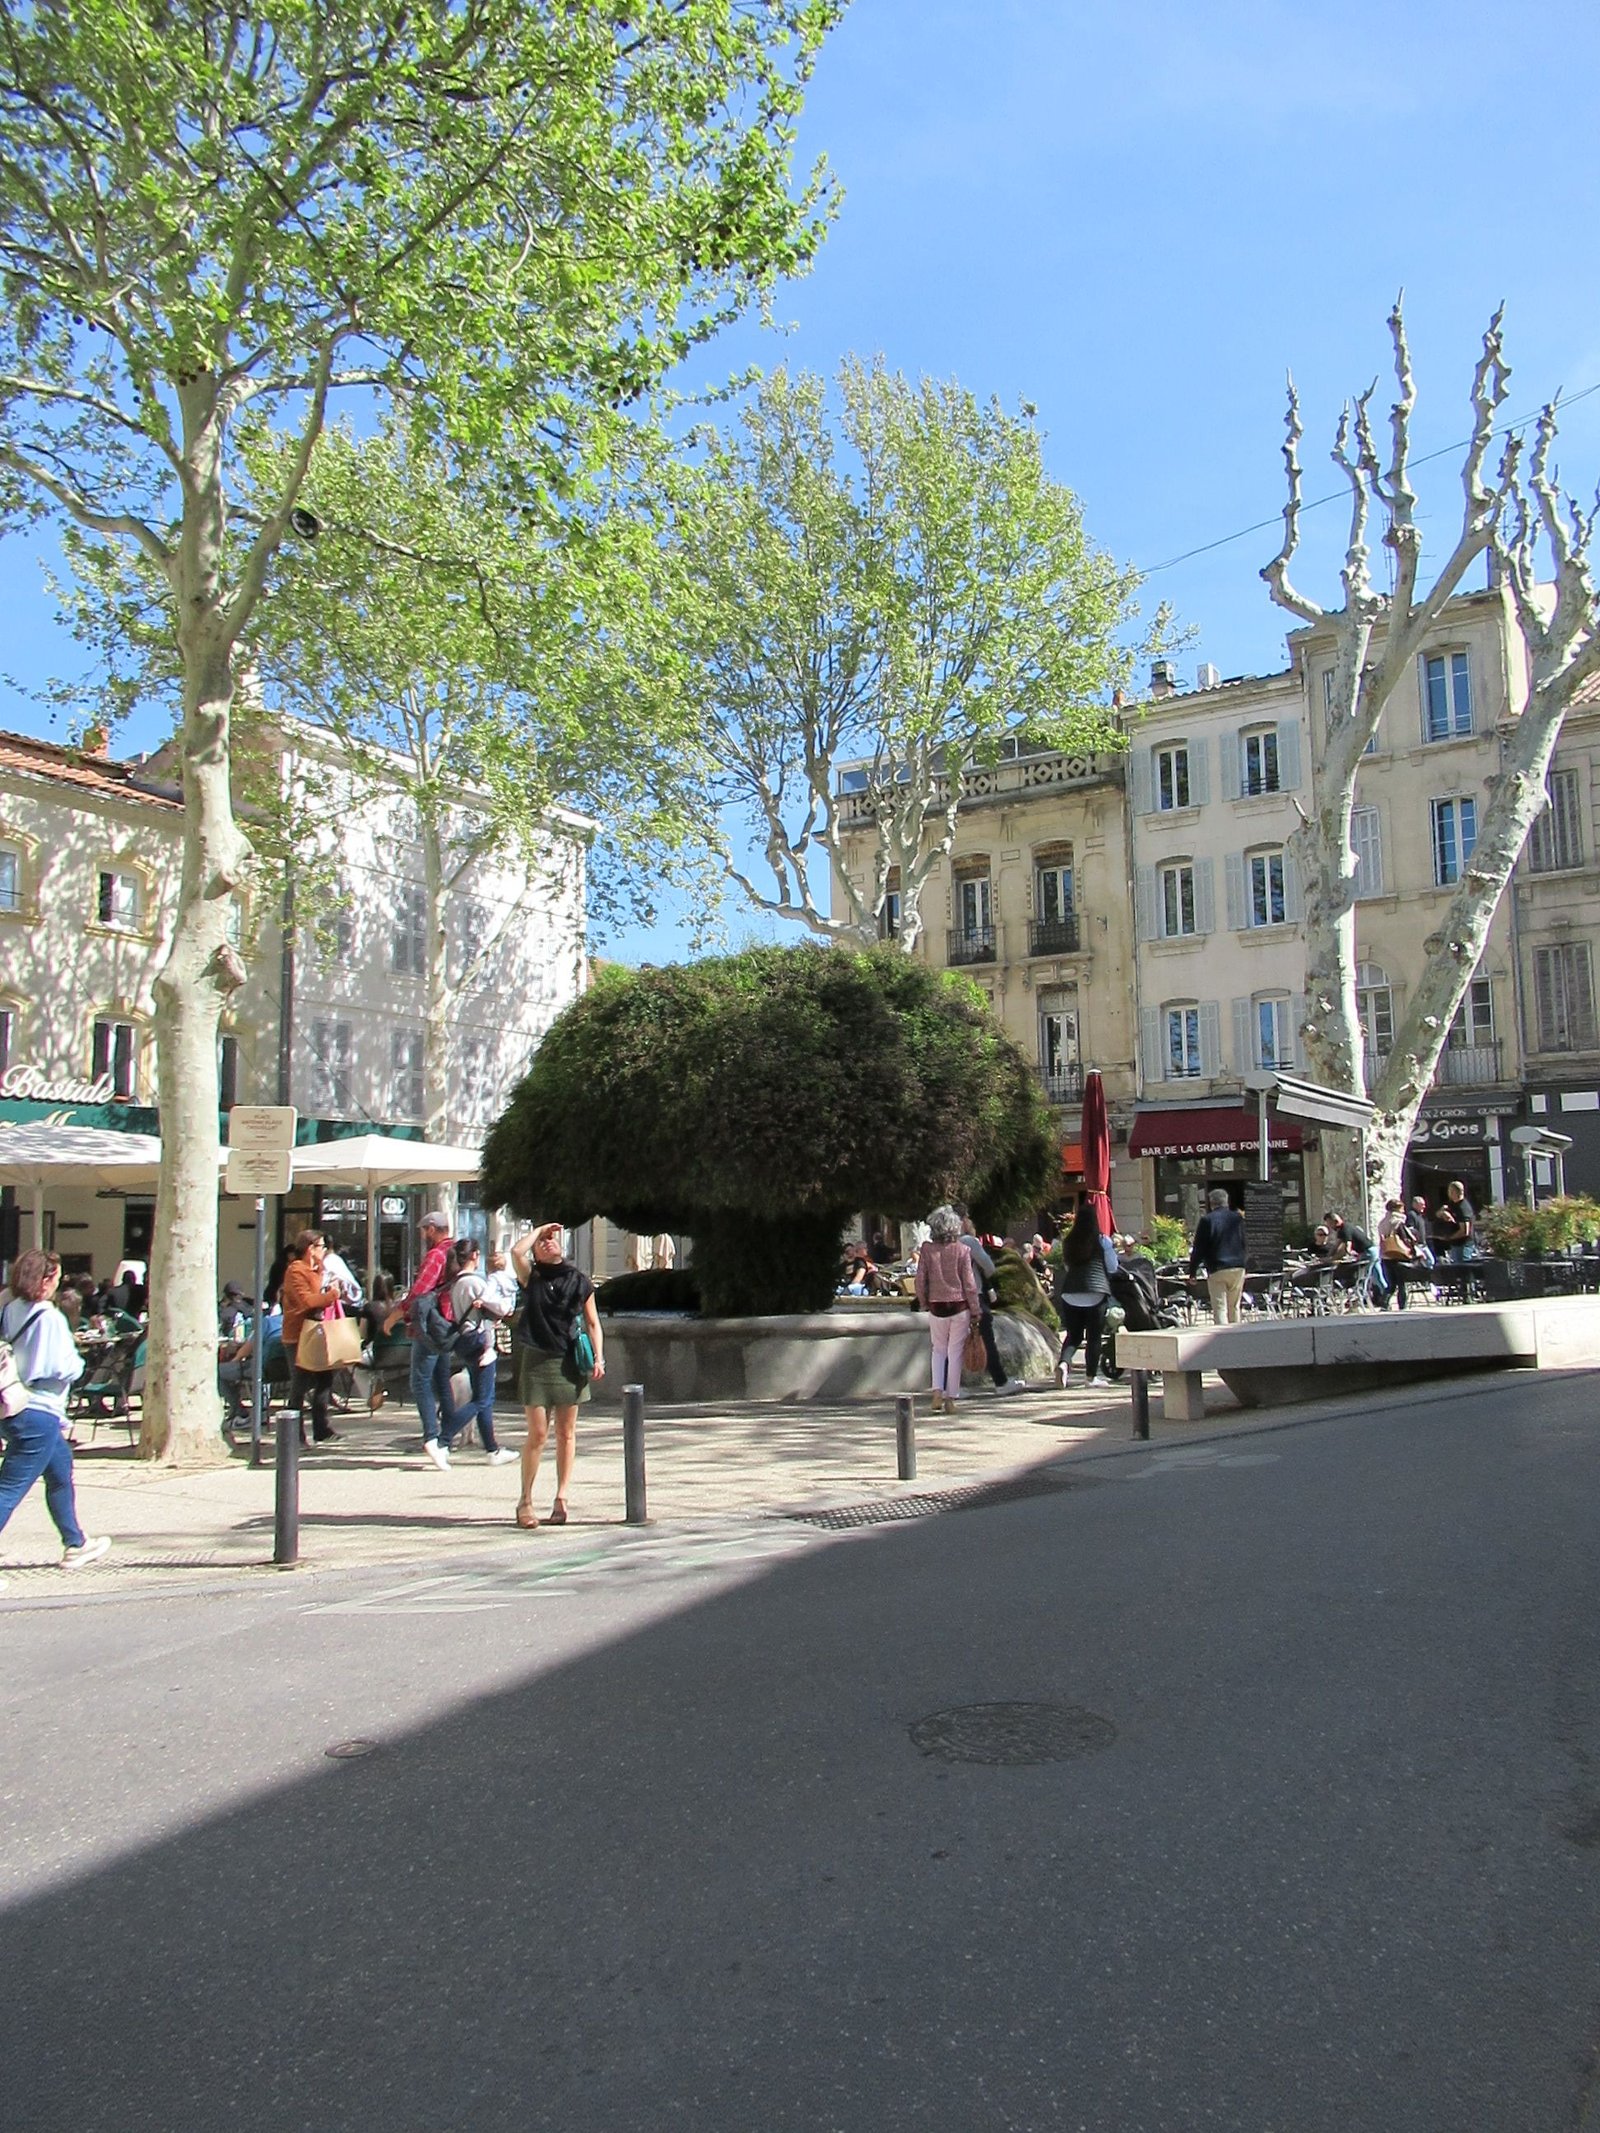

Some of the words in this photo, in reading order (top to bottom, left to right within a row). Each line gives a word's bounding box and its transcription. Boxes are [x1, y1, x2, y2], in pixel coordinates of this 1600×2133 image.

[0, 1064, 115, 1104] Bastide
[1411, 1119, 1430, 1142] 2
[1432, 1120, 1479, 1140] Gros
[1141, 1146, 1161, 1156] BAR
[1164, 1146, 1177, 1155] DE
[1180, 1145, 1194, 1154] LA
[1196, 1142, 1237, 1153] GRANDE
[1240, 1139, 1289, 1151] FONAINE
